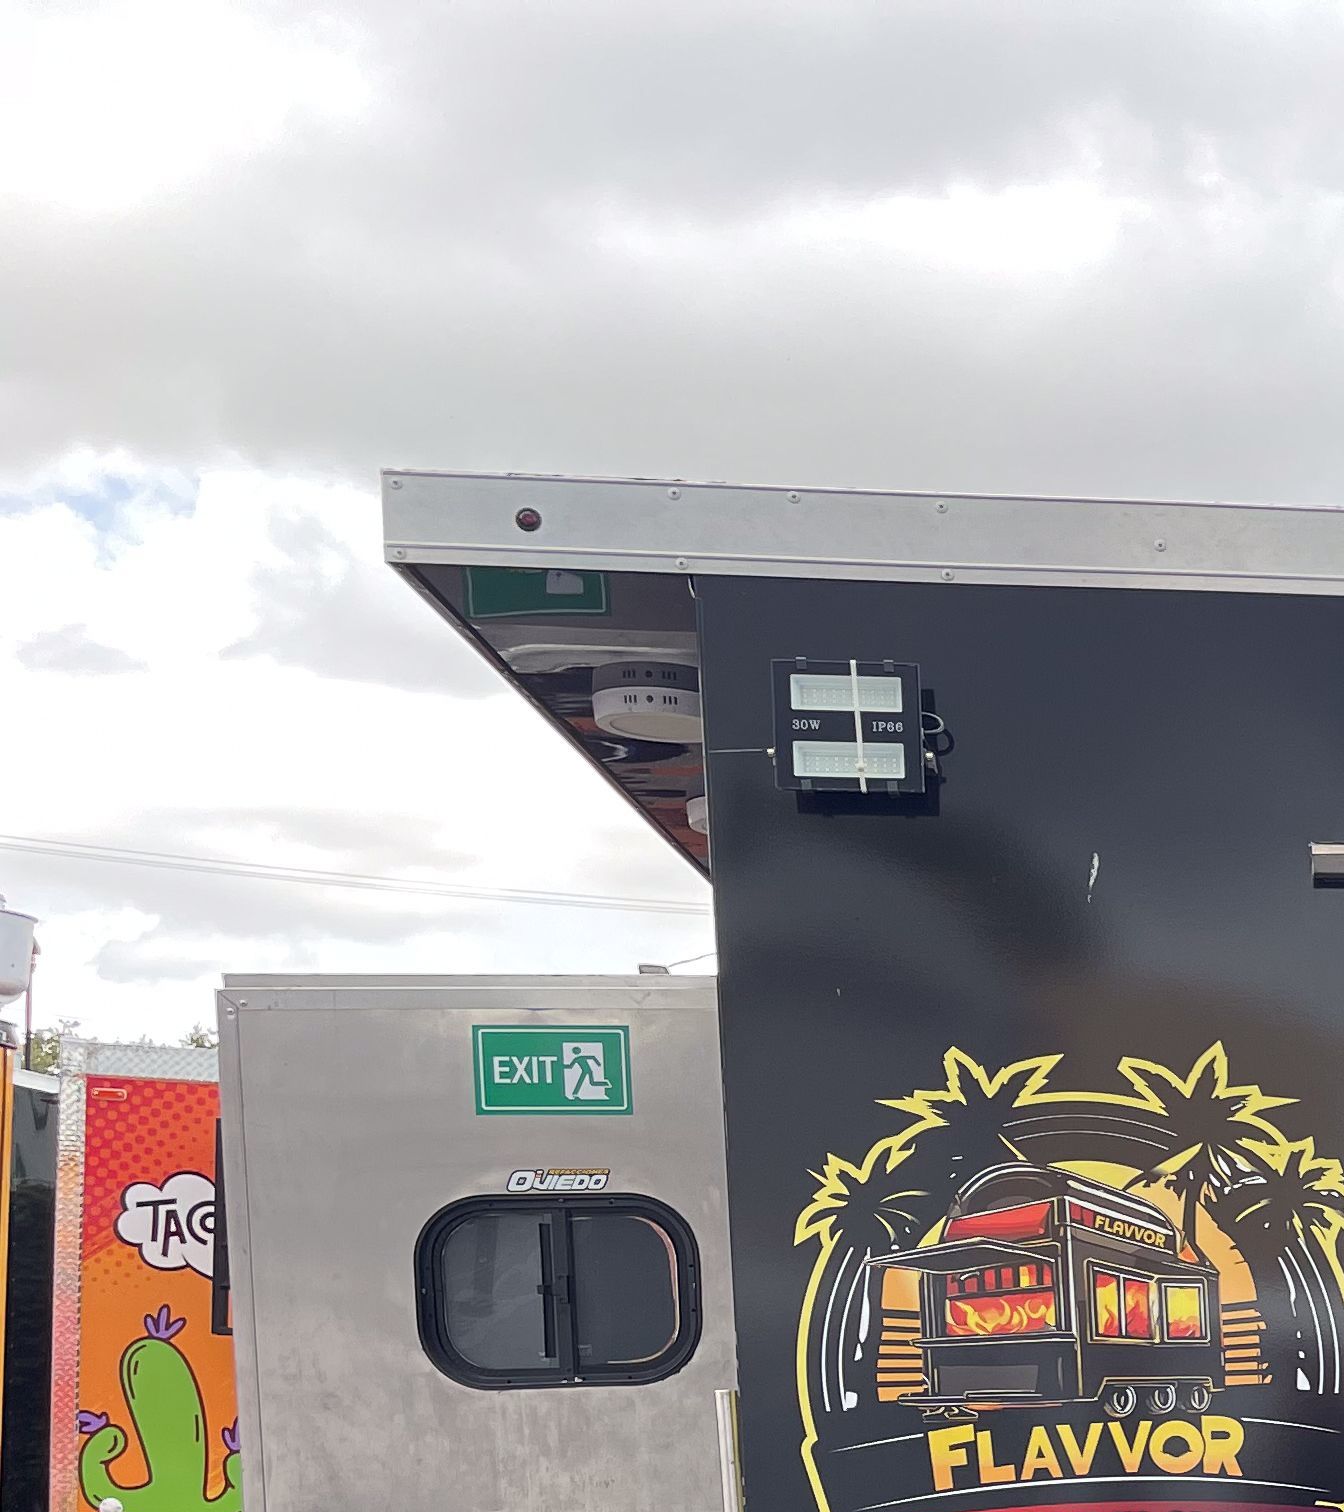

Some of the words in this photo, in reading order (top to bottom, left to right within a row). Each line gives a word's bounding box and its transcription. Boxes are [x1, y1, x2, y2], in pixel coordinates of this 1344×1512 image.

[792, 719, 820, 730] 30W
[872, 721, 903, 732] IP66
[492, 1055, 557, 1086] EXIT
[1093, 1214, 1166, 1249] FLAVVOR
[927, 1415, 1245, 1491] FLAVVOR
